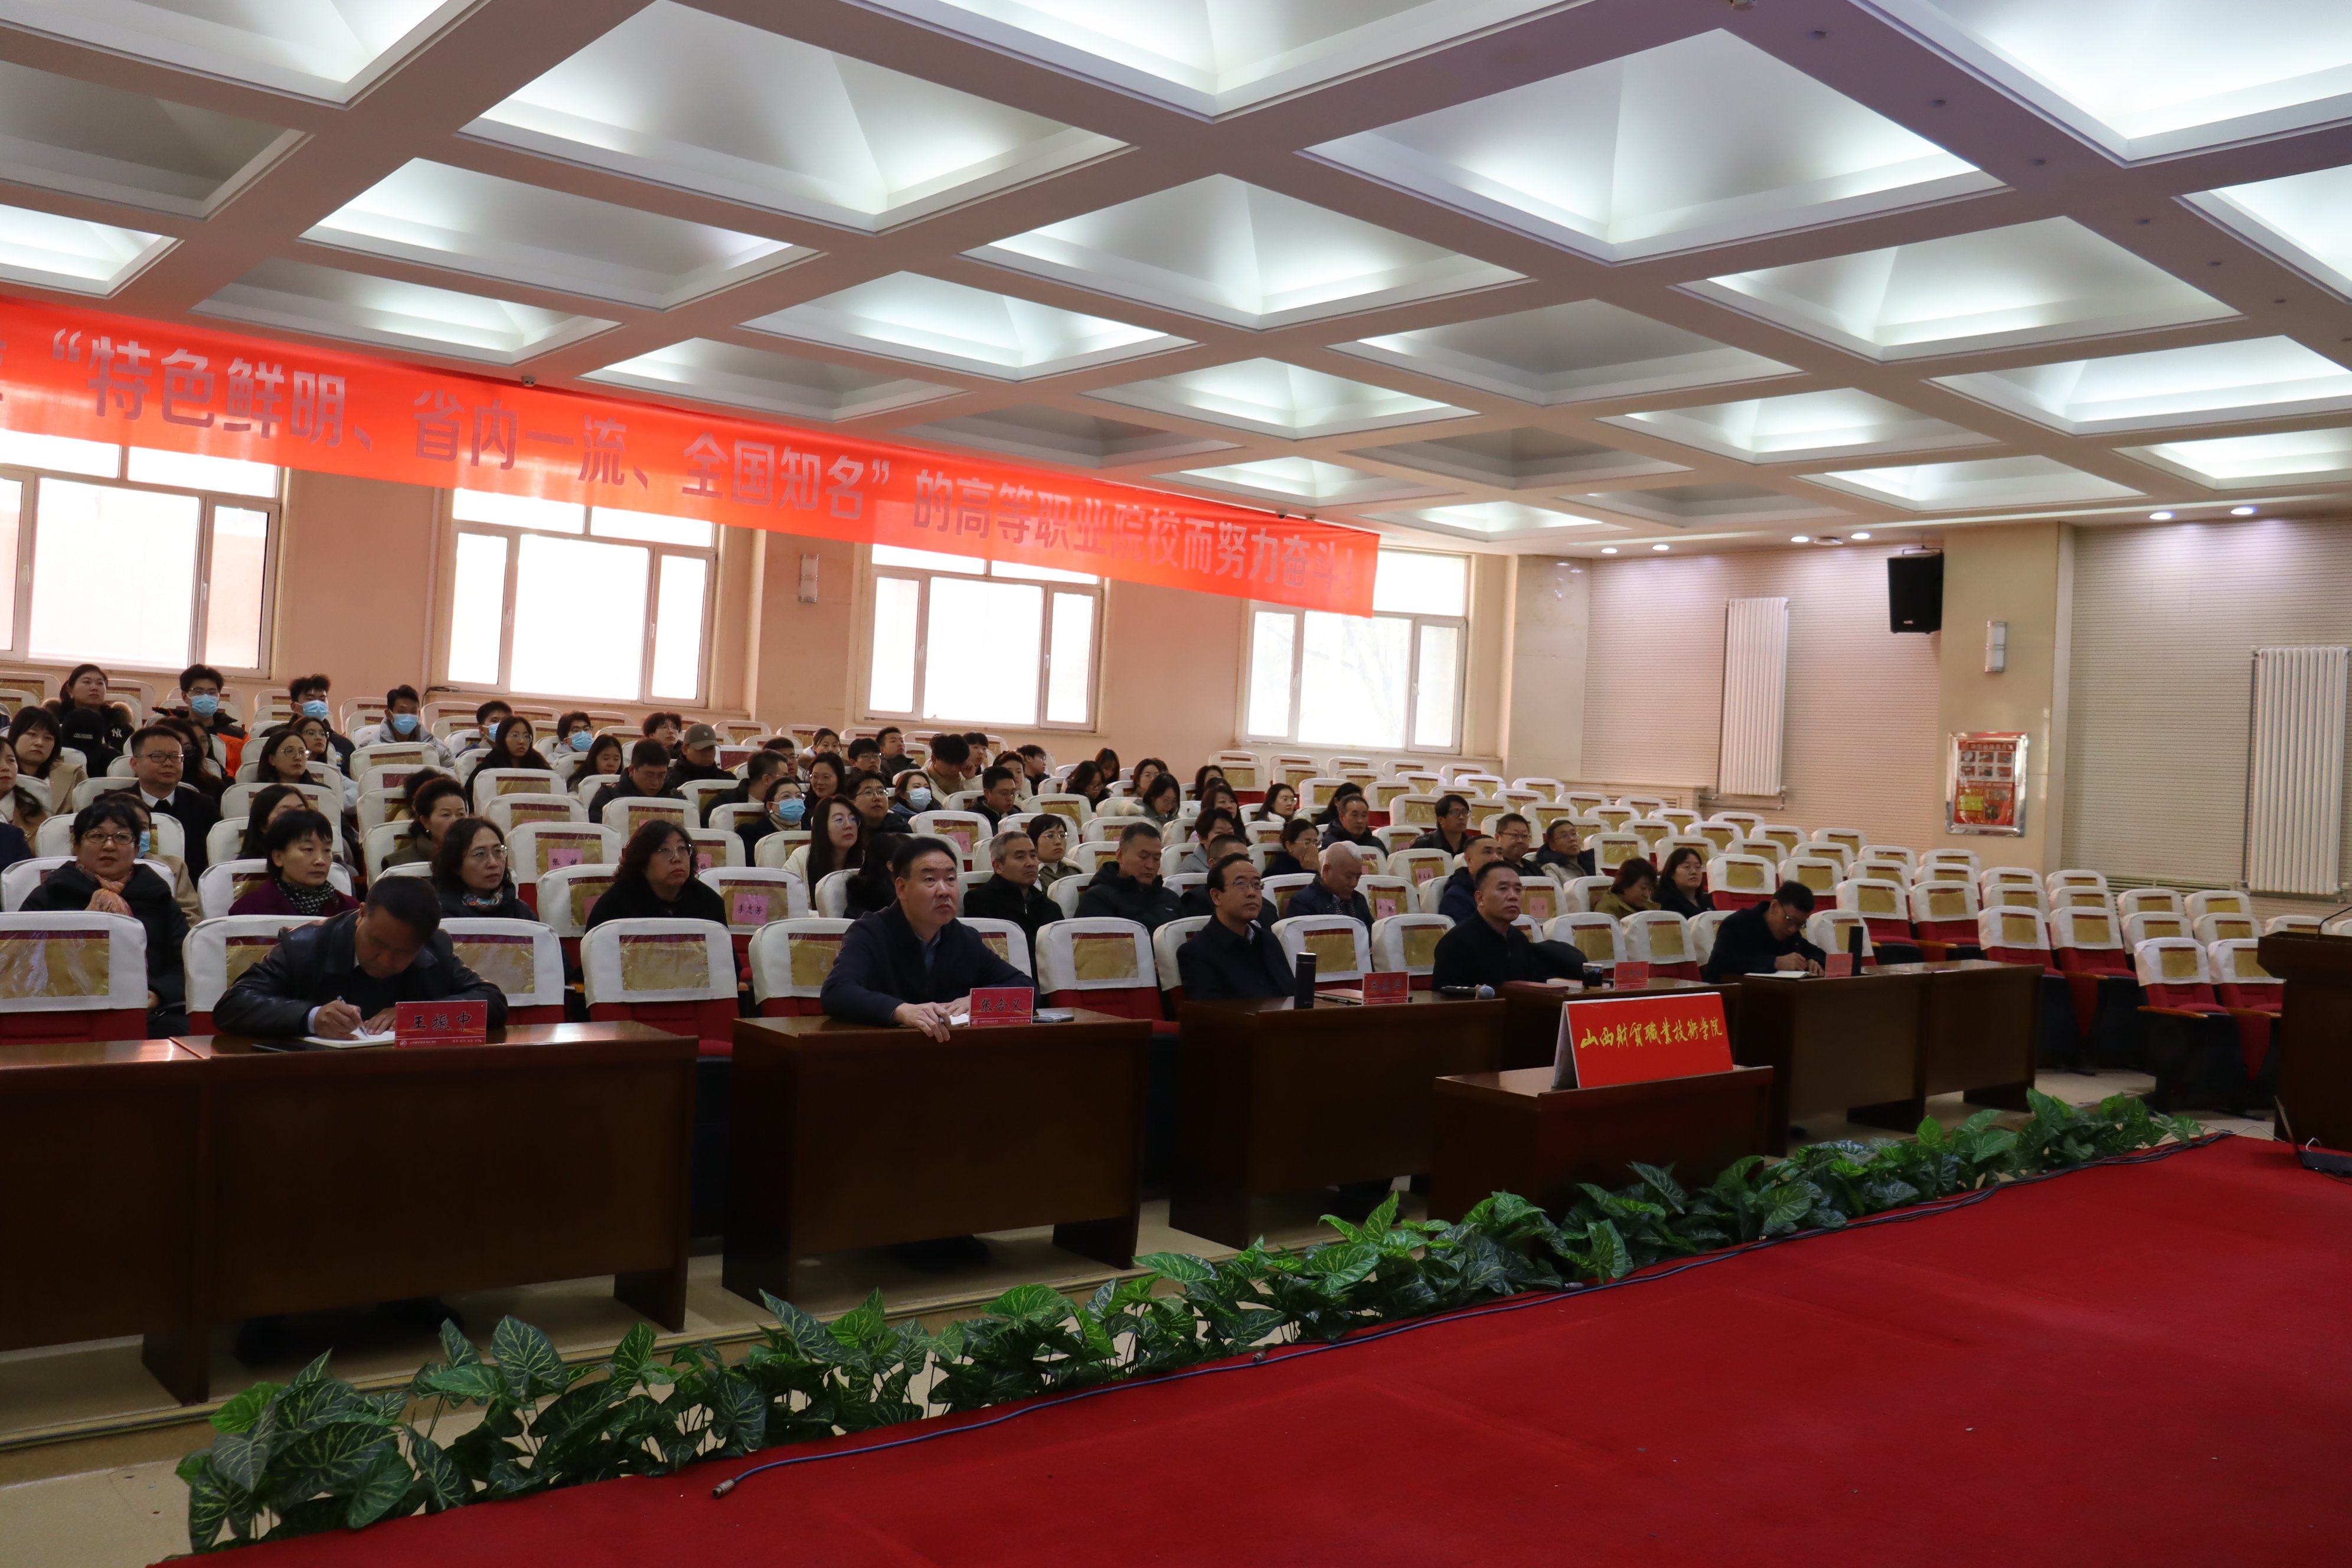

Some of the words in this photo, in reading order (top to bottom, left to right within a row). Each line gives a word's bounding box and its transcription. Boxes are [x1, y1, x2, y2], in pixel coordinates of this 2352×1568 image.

[981, 997, 1023, 1012] 张合义
[410, 1011, 472, 1031] 王振中
